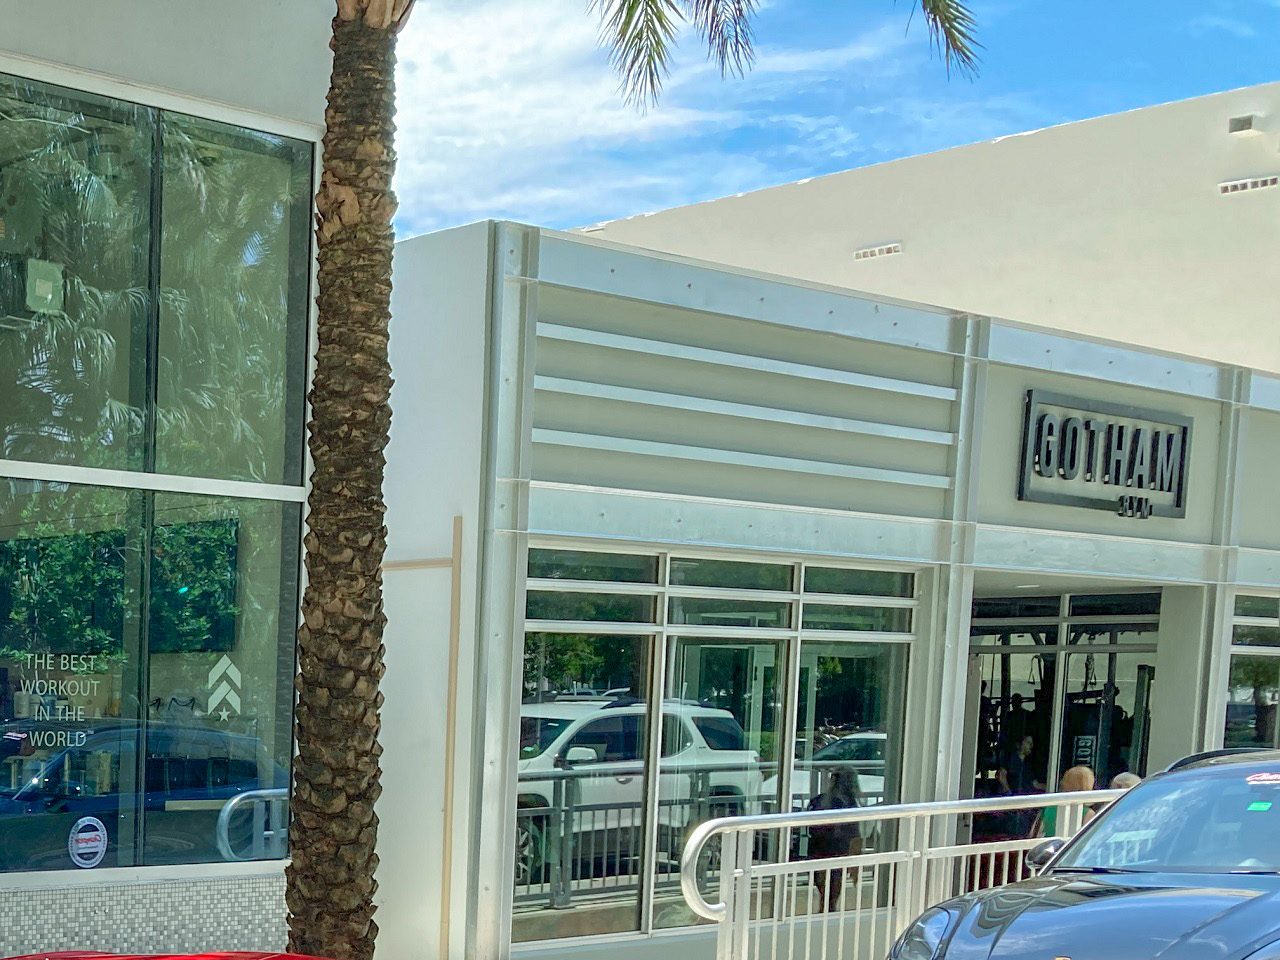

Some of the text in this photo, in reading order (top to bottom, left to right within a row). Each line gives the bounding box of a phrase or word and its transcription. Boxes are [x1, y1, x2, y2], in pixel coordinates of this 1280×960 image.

[1034, 413, 1182, 492] GOTHAM
[24, 653, 97, 671] THE BEST
[20, 679, 100, 696] WORKOUT
[34, 706, 85, 722] IN THE
